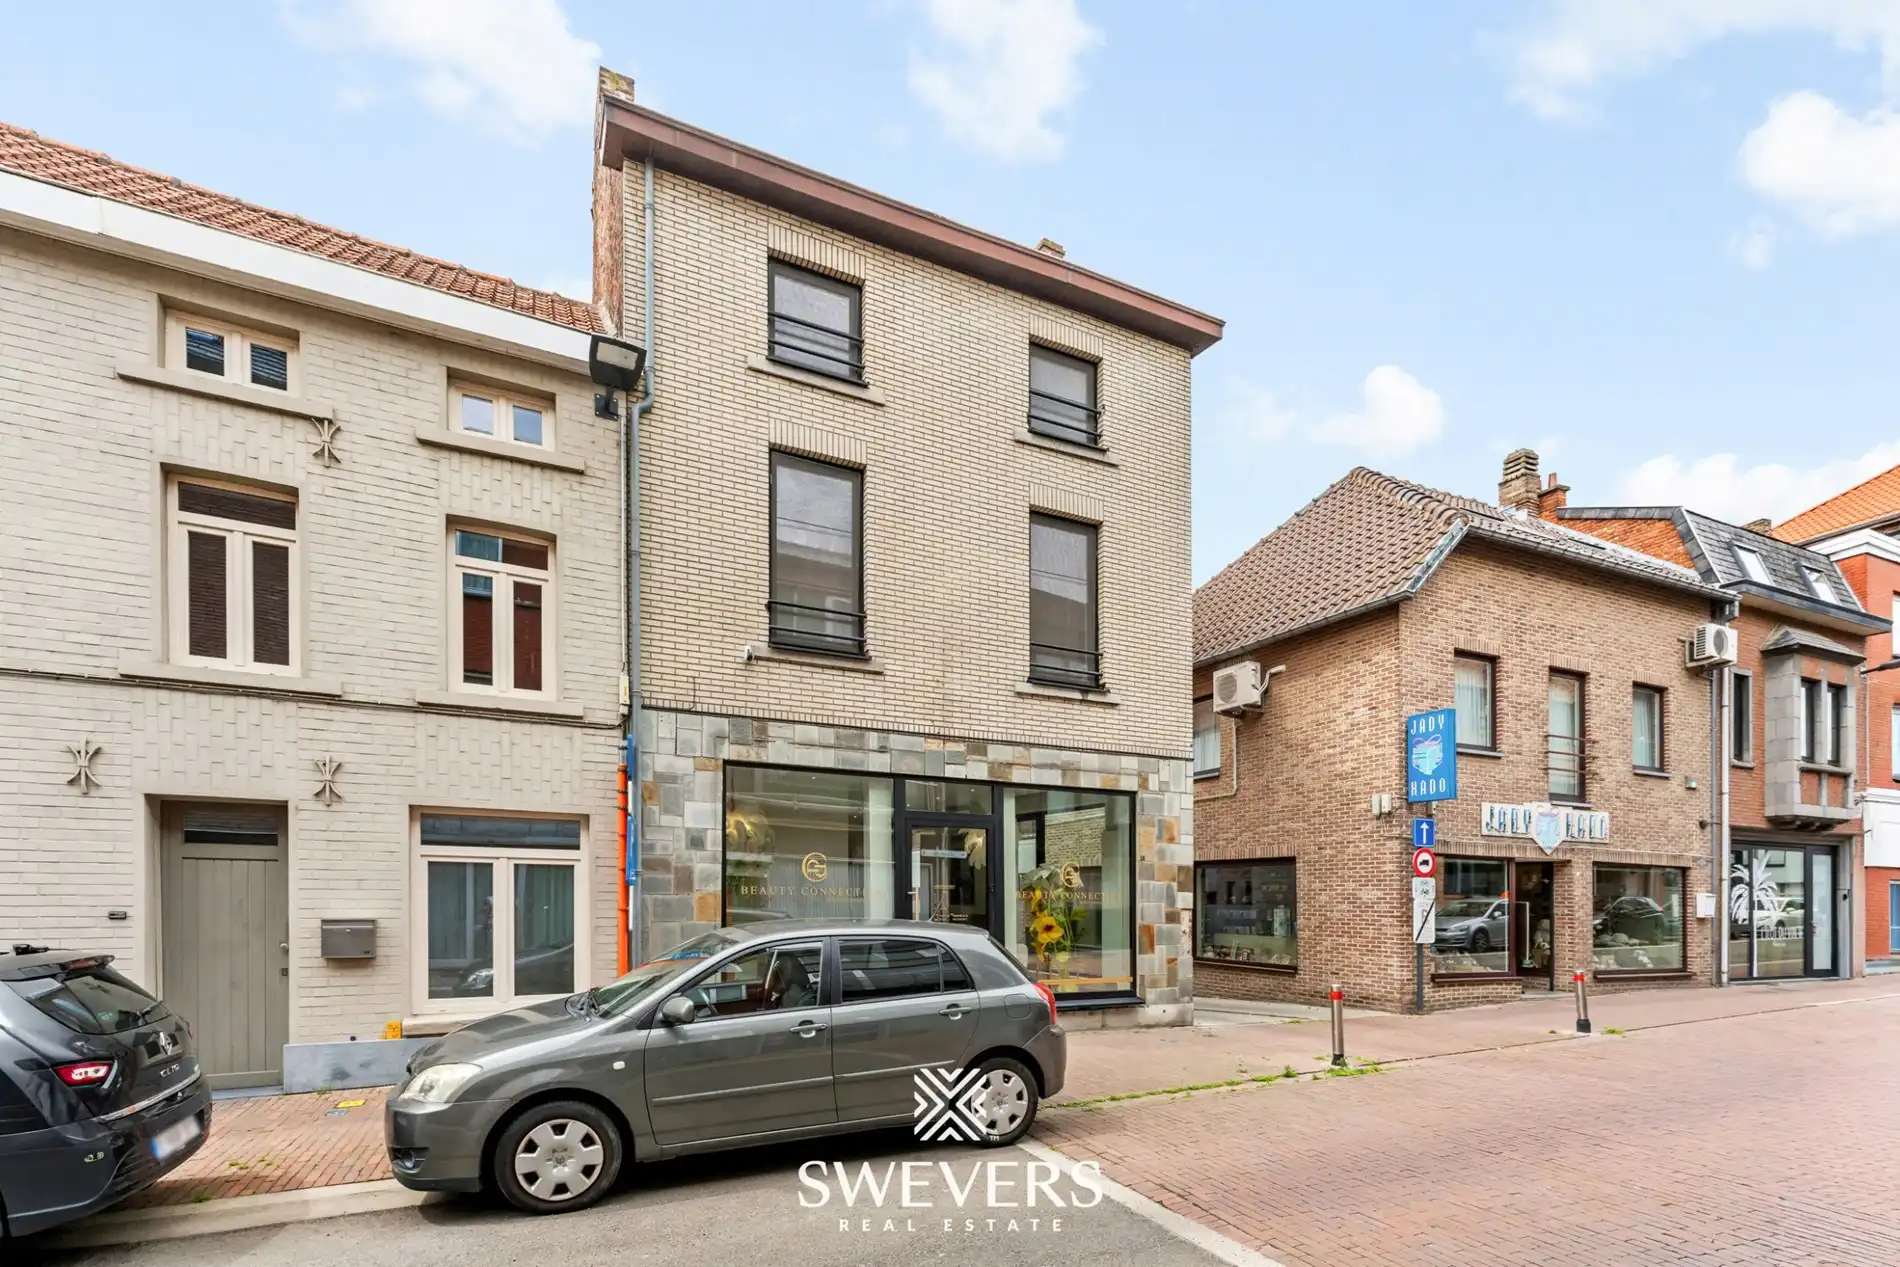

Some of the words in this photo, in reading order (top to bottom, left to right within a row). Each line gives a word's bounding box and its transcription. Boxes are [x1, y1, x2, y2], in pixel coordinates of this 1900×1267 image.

[1410, 714, 1445, 736] JADY
[740, 885, 795, 896] BEAUTY
[1015, 890, 1057, 901] BEATY
